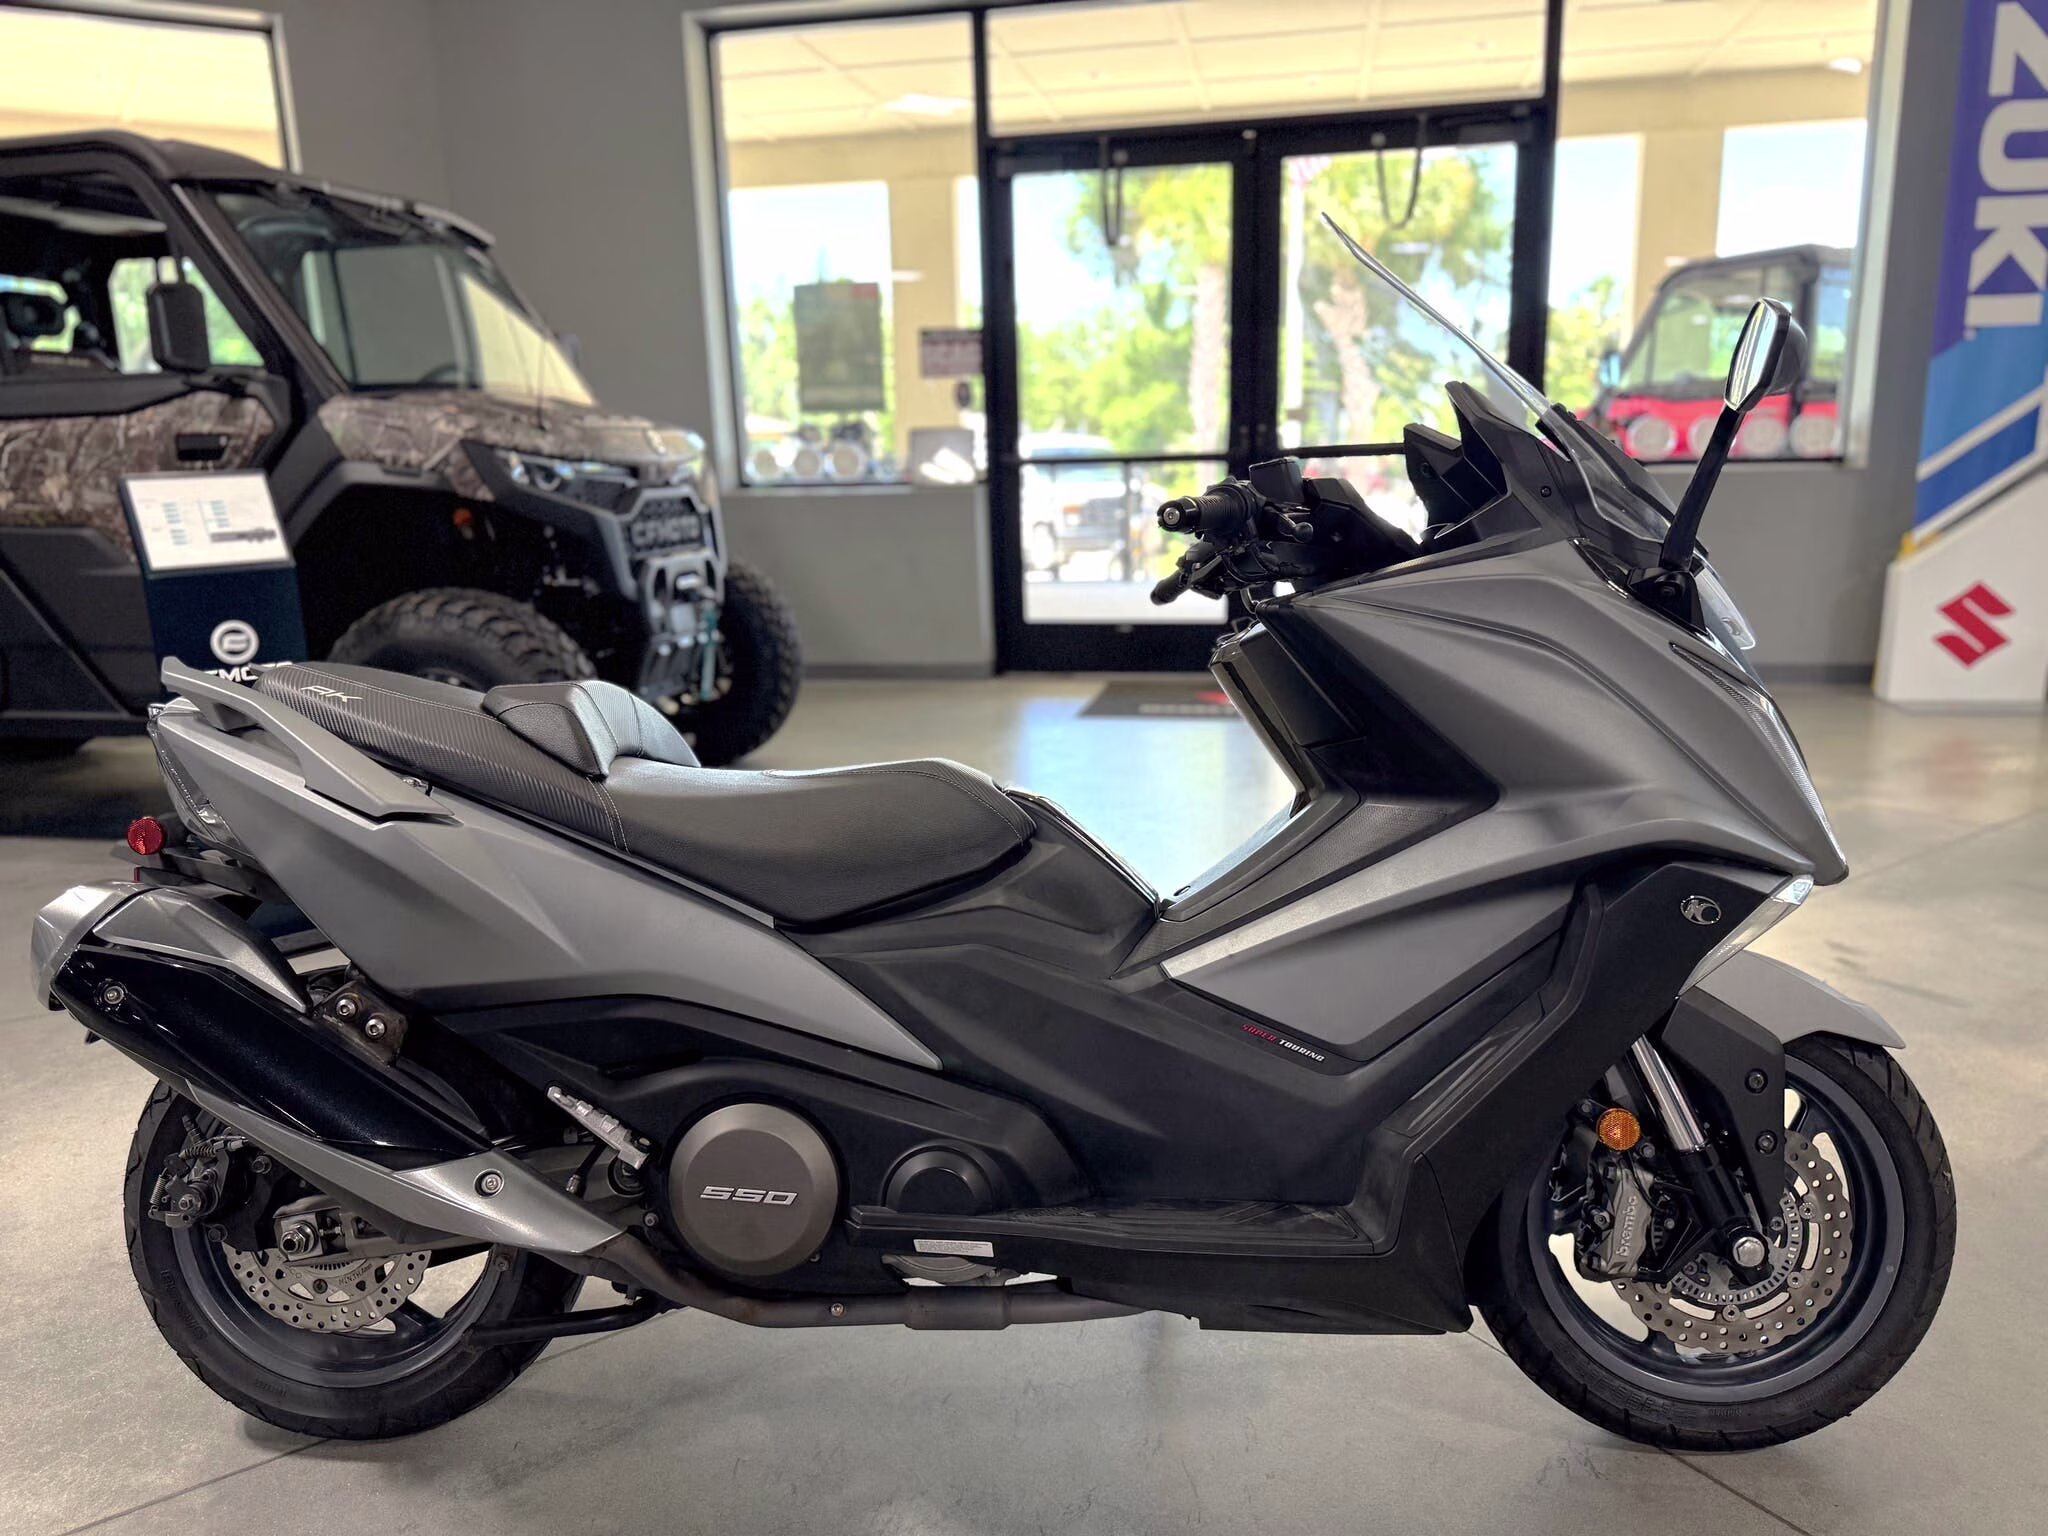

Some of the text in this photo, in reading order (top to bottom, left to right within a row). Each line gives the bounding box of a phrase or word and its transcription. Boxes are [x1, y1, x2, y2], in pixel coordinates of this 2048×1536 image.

[1279, 1039, 1325, 1062] TOURING
[700, 1186, 798, 1206] 550
[1616, 1195, 1638, 1257] brembo
